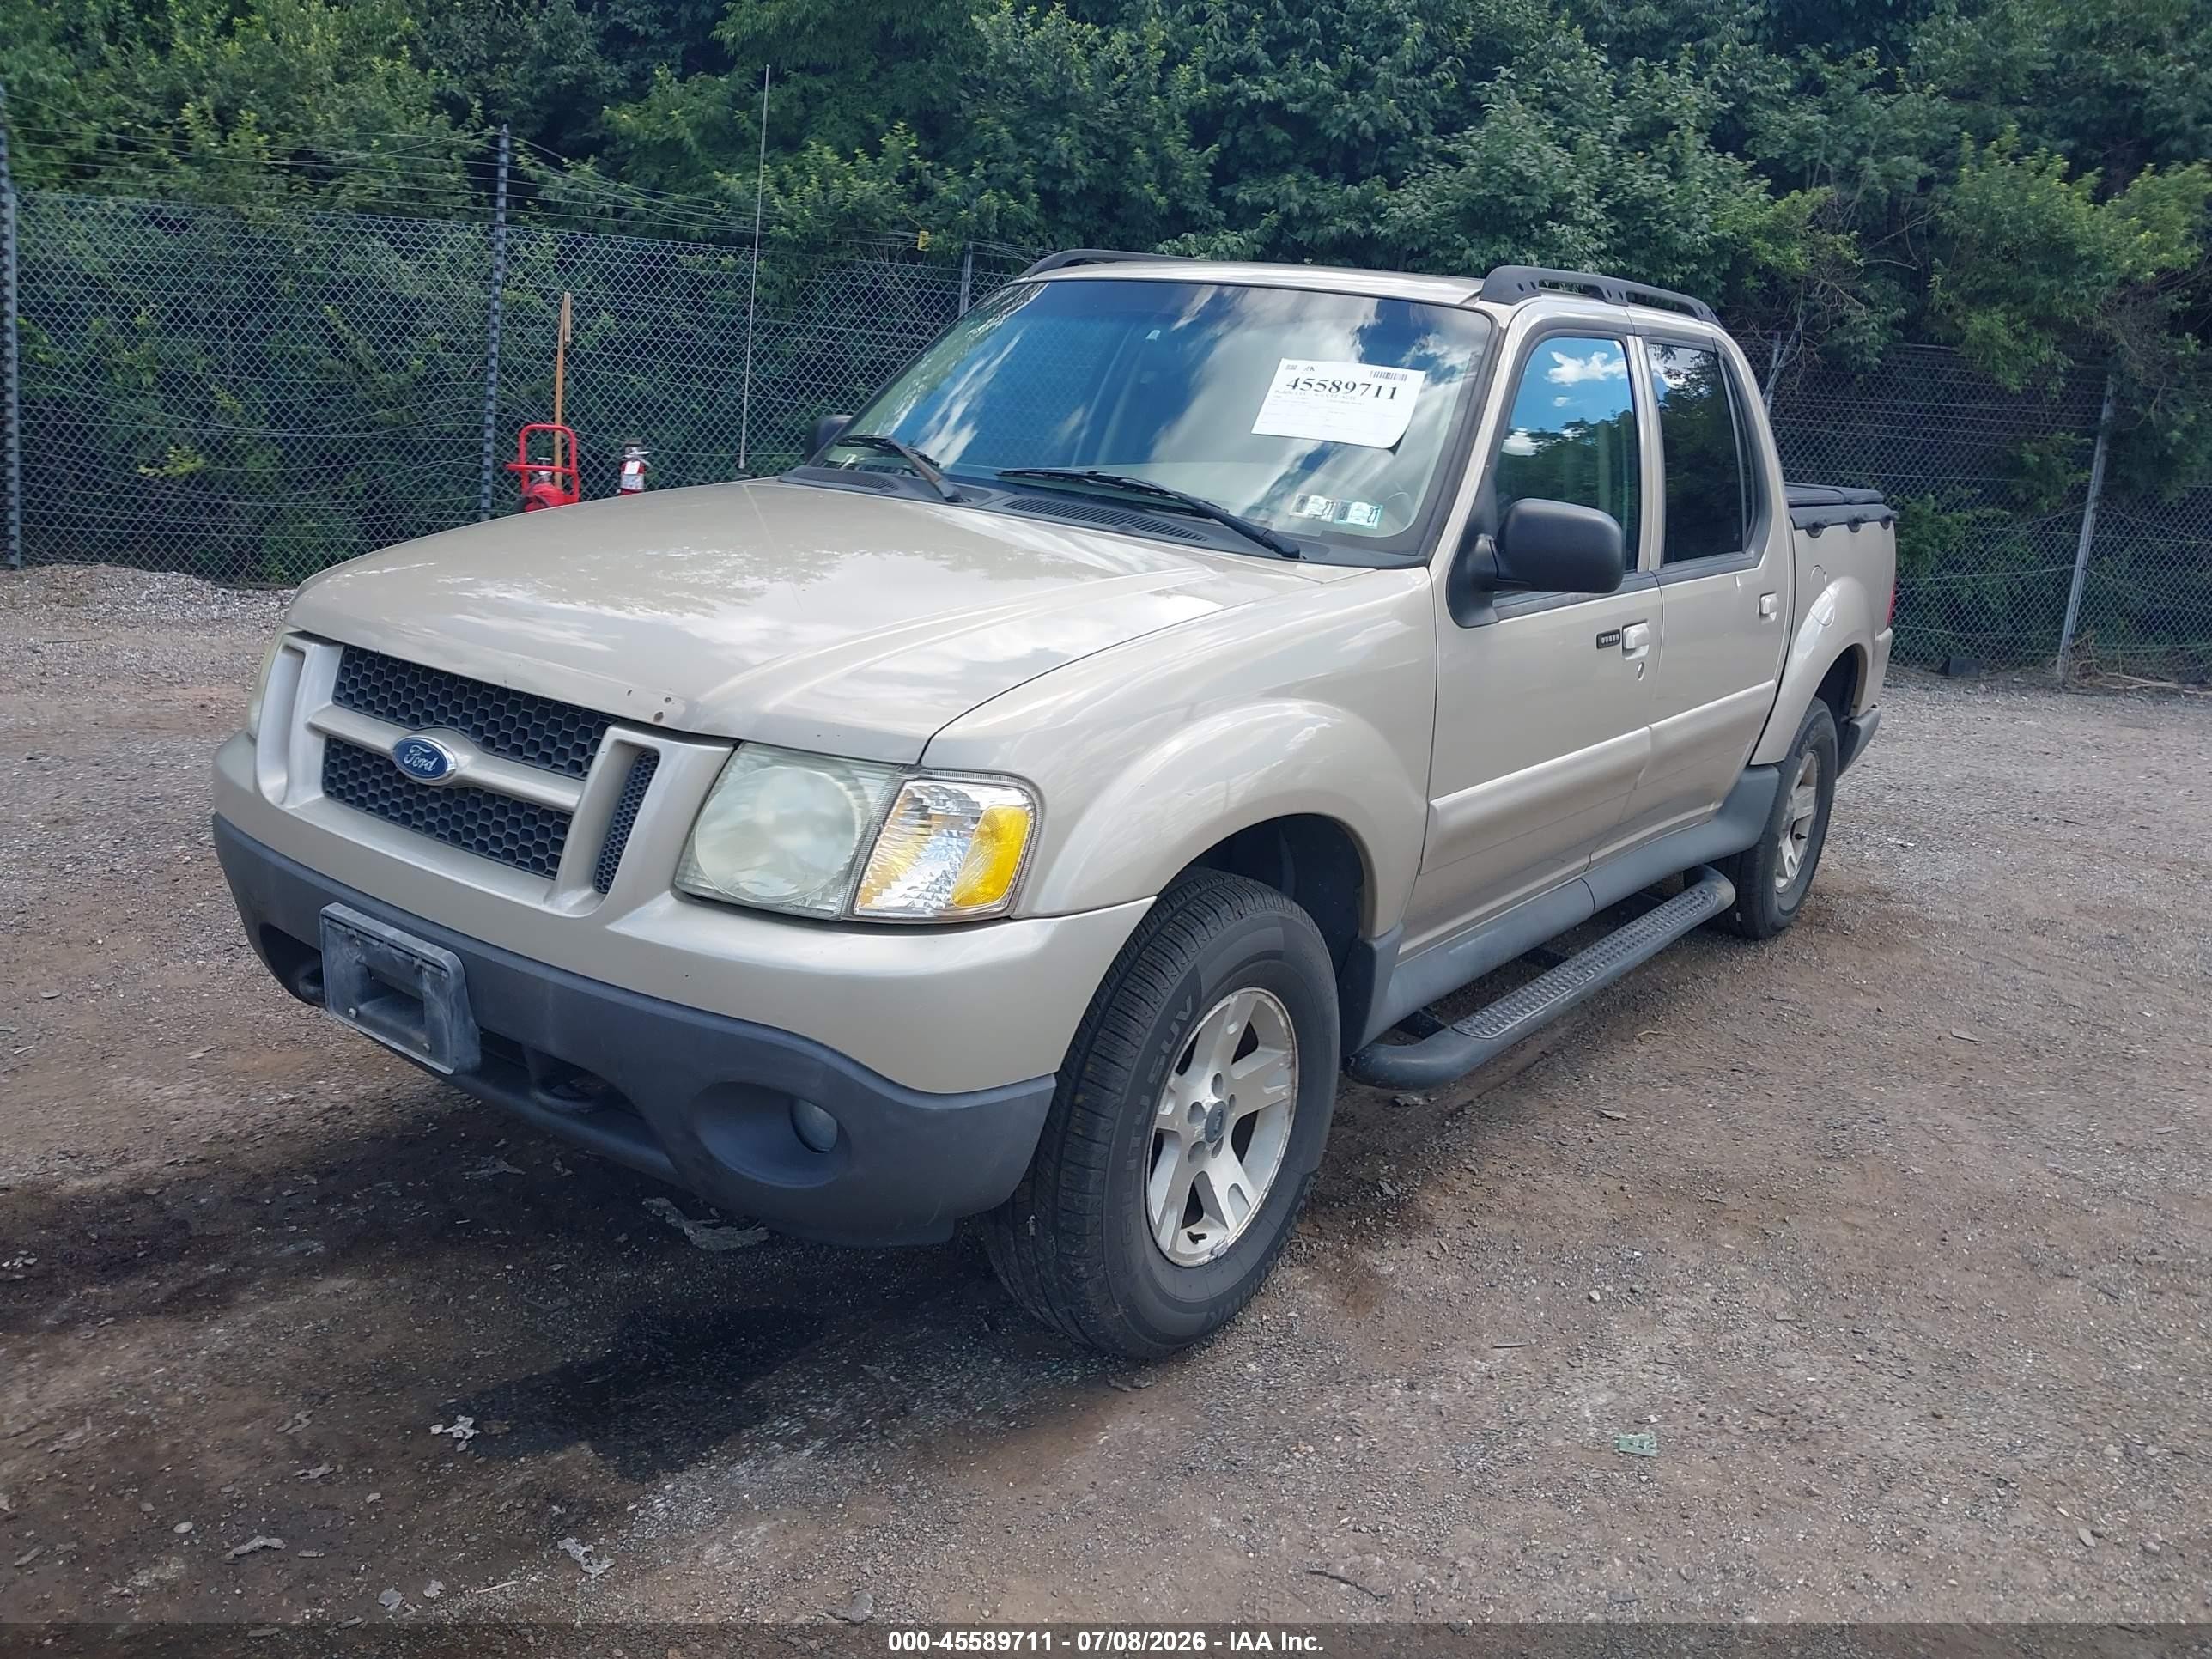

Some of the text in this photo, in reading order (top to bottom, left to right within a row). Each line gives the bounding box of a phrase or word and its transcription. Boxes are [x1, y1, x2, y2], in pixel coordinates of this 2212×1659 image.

[1286, 377, 1398, 400] 45589711
[1366, 507, 1380, 523] 27
[404, 744, 439, 772] Ford
[1147, 994, 1193, 1085] SUV
